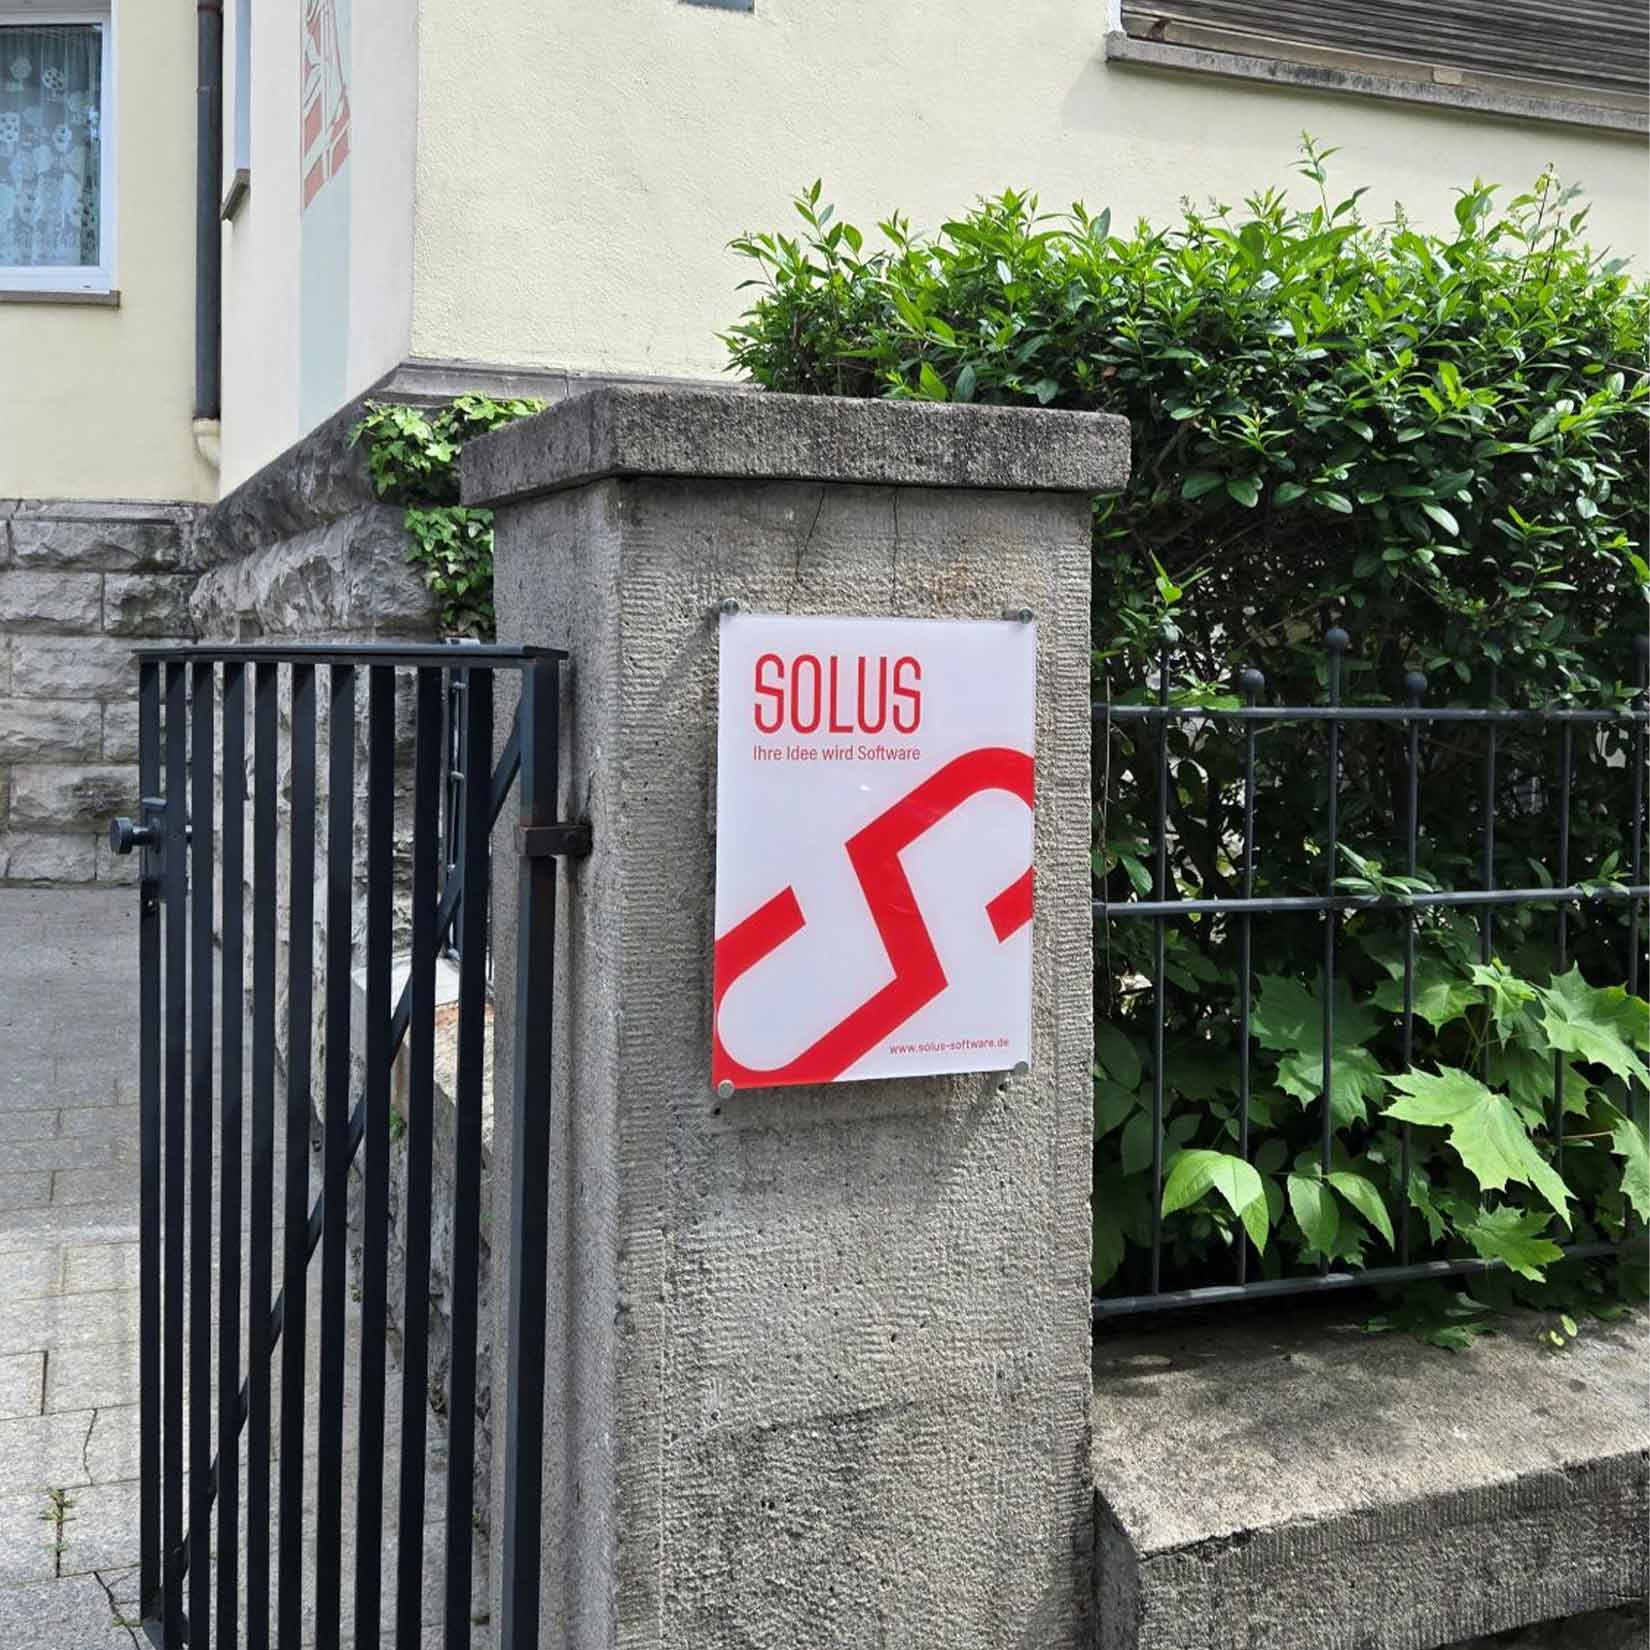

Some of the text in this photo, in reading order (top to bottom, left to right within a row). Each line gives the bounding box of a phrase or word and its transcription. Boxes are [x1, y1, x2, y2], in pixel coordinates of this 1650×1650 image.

[754, 653, 922, 734] SOLUS
[753, 745, 921, 761] Ihre Idee wird Software
[889, 1038, 1009, 1054] www.solus-software.de
